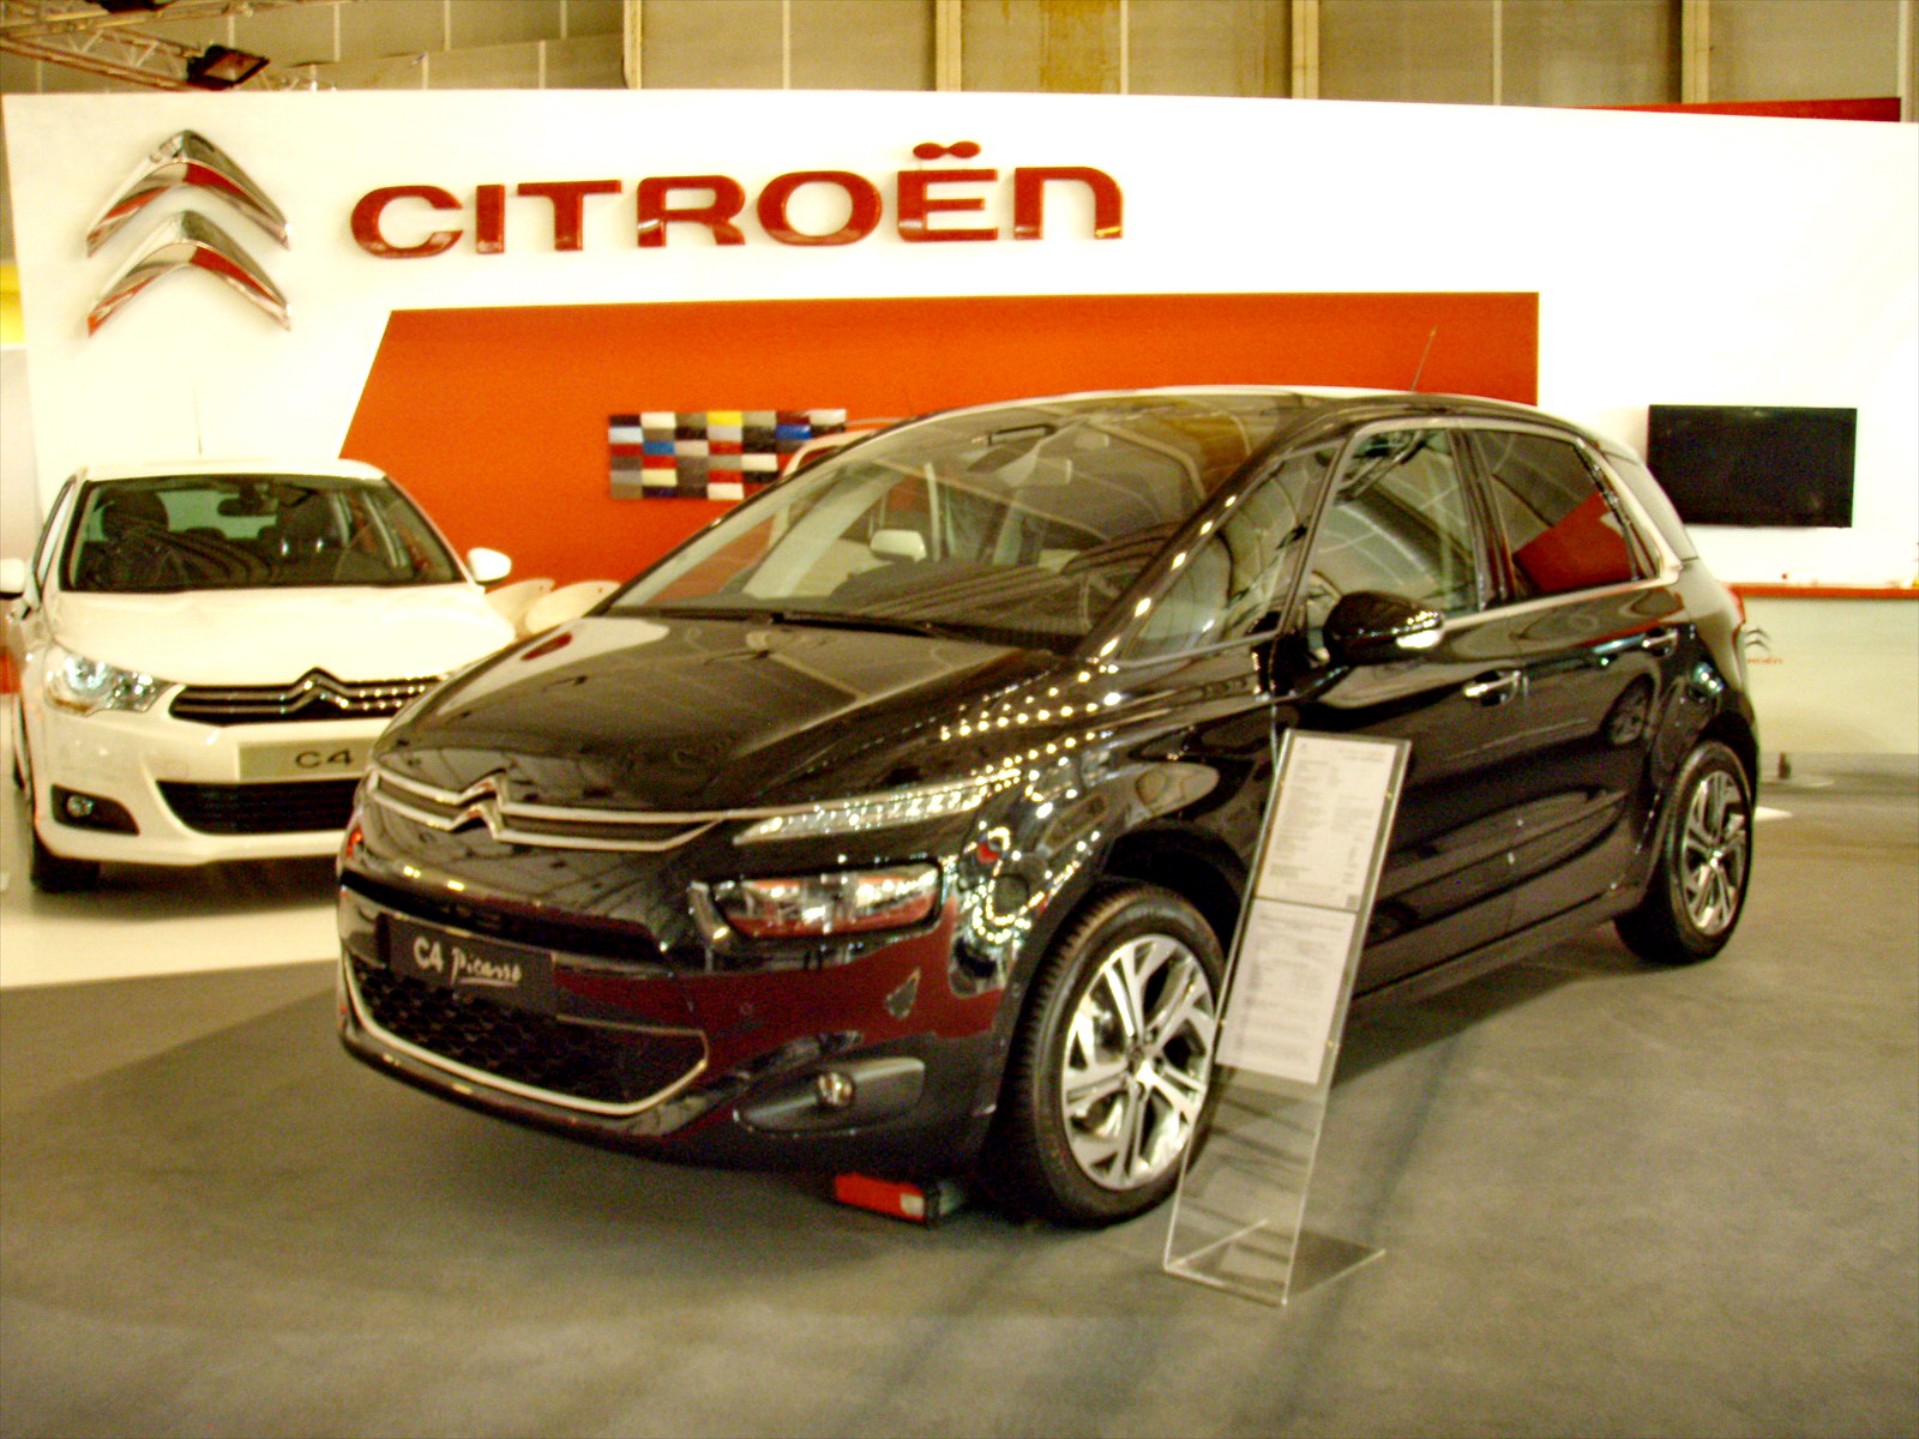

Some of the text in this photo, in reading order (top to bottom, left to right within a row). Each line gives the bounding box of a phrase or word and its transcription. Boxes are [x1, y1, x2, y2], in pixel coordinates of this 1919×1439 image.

[350, 139, 1123, 259] CITROËN
[295, 749, 352, 768] C4
[413, 936, 444, 974] C4
